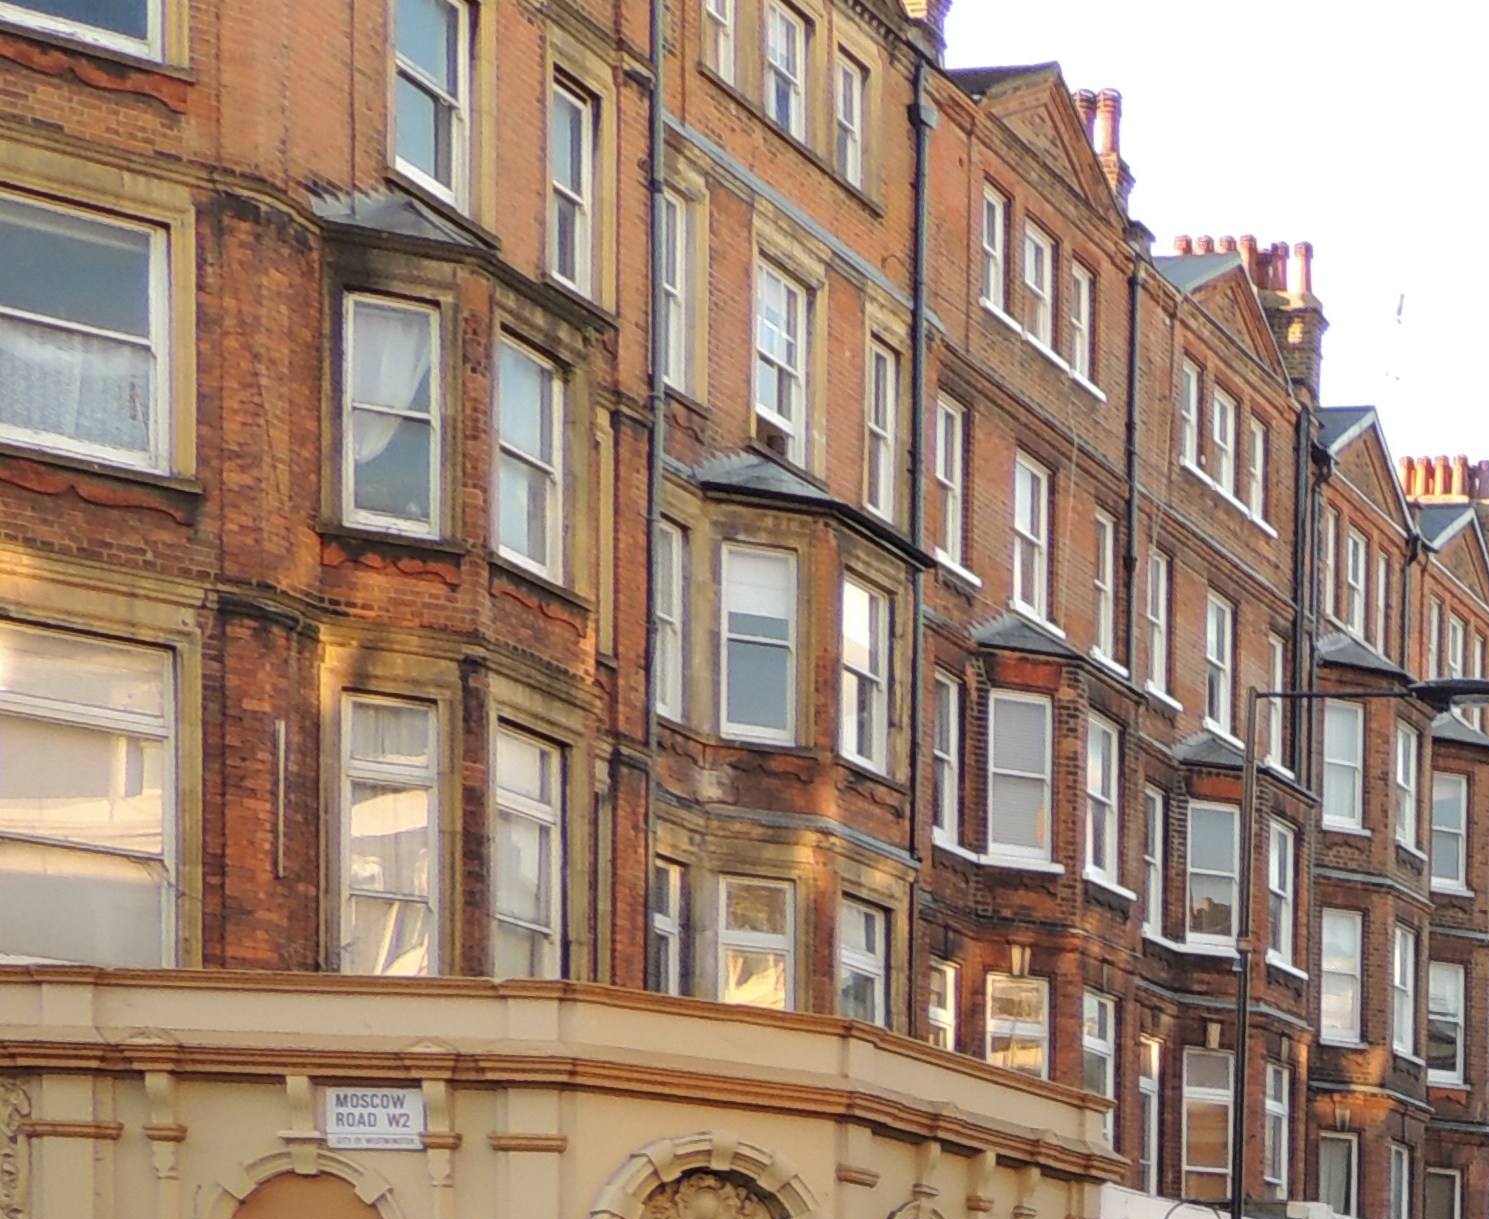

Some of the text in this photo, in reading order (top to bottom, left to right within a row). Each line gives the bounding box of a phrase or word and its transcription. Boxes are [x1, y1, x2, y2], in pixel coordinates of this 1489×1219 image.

[335, 1093, 407, 1110] MOSCOW
[335, 1112, 411, 1128] ROAD W2
